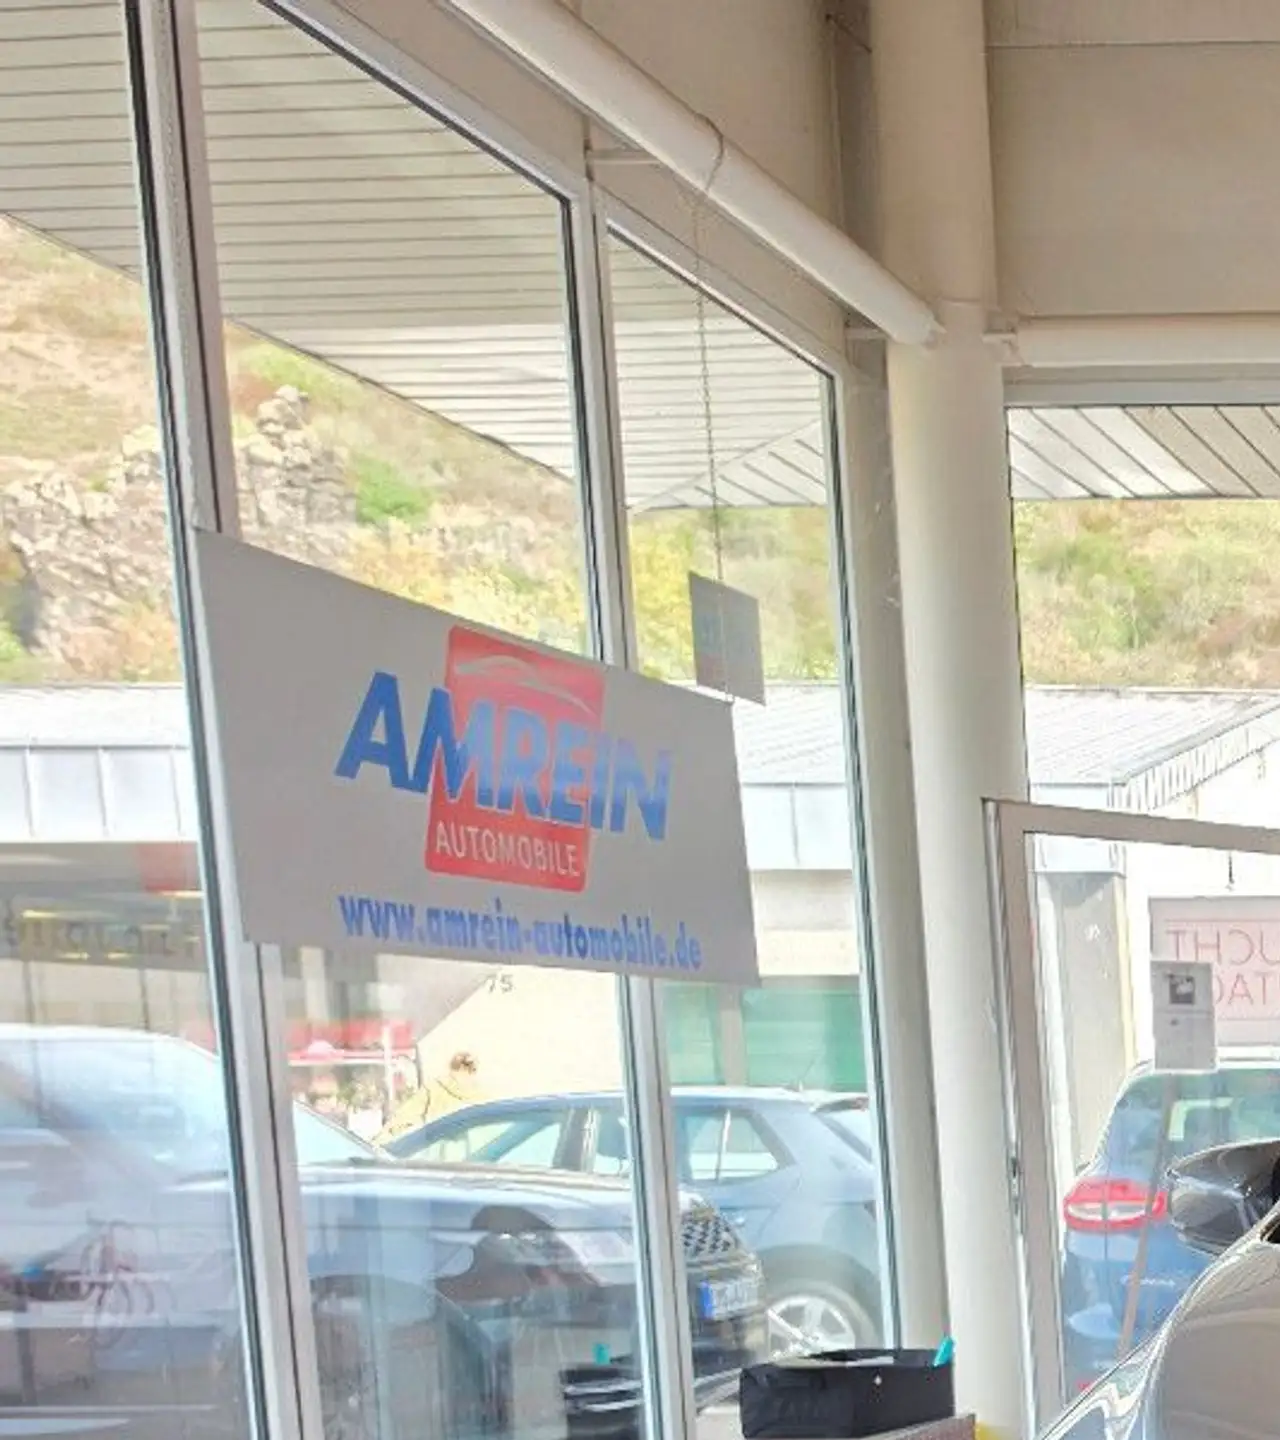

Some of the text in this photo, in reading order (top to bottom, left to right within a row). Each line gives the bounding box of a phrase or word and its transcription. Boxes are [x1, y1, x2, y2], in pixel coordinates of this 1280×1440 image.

[334, 671, 674, 840] AMREIN
[434, 820, 582, 878] AUTOMOBILE
[337, 895, 703, 969] www.amrein-automobile.de
